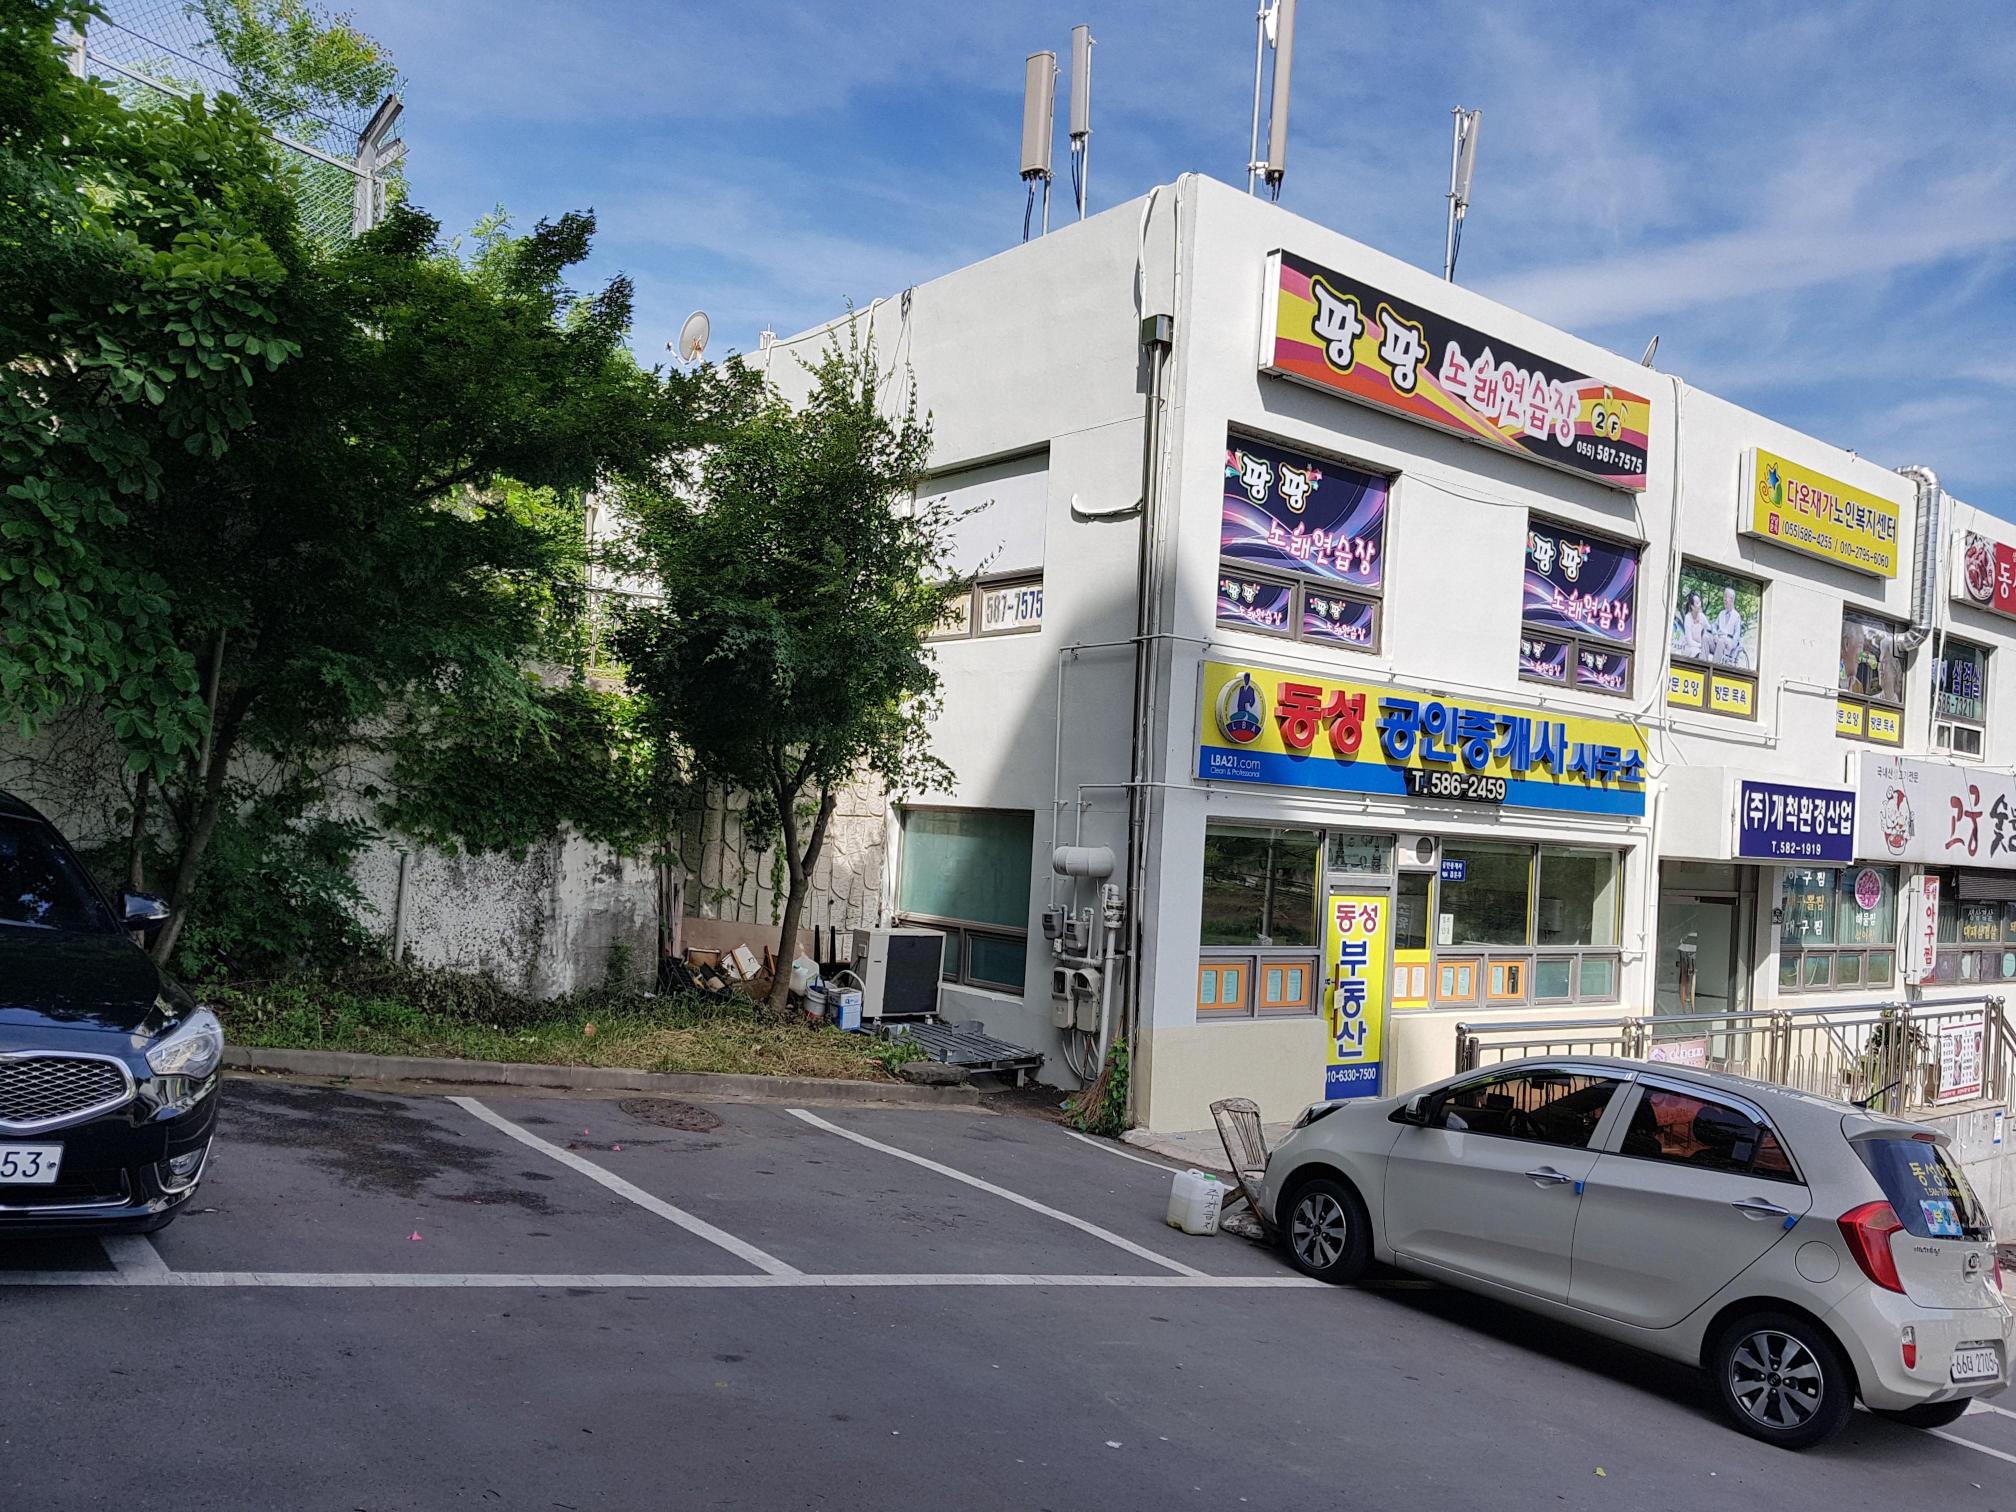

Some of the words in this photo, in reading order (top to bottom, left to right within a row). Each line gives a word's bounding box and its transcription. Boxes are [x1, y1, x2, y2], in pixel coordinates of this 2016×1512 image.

[1444, 345, 1578, 445] 노래연습장
[1597, 444, 1644, 474] 587-7575
[1786, 479, 1897, 544] 다온재가노인복지센터
[1266, 520, 1376, 576] 노래연습장
[986, 589, 1043, 624] 587-7575
[1551, 587, 1629, 632] 노래연습장
[1682, 679, 1700, 697] 요양
[1714, 685, 1730, 701] 방문
[1231, 721, 1257, 734] LBA
[1274, 681, 1367, 755] 동성
[1374, 696, 1569, 775] 공인중개사
[1567, 742, 1646, 784] 사무소
[1846, 711, 1859, 727] 요양
[1210, 753, 1261, 770] LBA21.com
[1411, 770, 1507, 801] T.586-2459
[1743, 789, 1853, 835] (주)개척환경산업
[1771, 840, 1822, 856] T.582-1919
[1788, 870, 1826, 887] 아구찜
[1335, 904, 1379, 933] 동성
[1785, 919, 1823, 936] 대구찜
[1922, 902, 1936, 966] 아구찜
[1335, 940, 1368, 1058] 부동산
